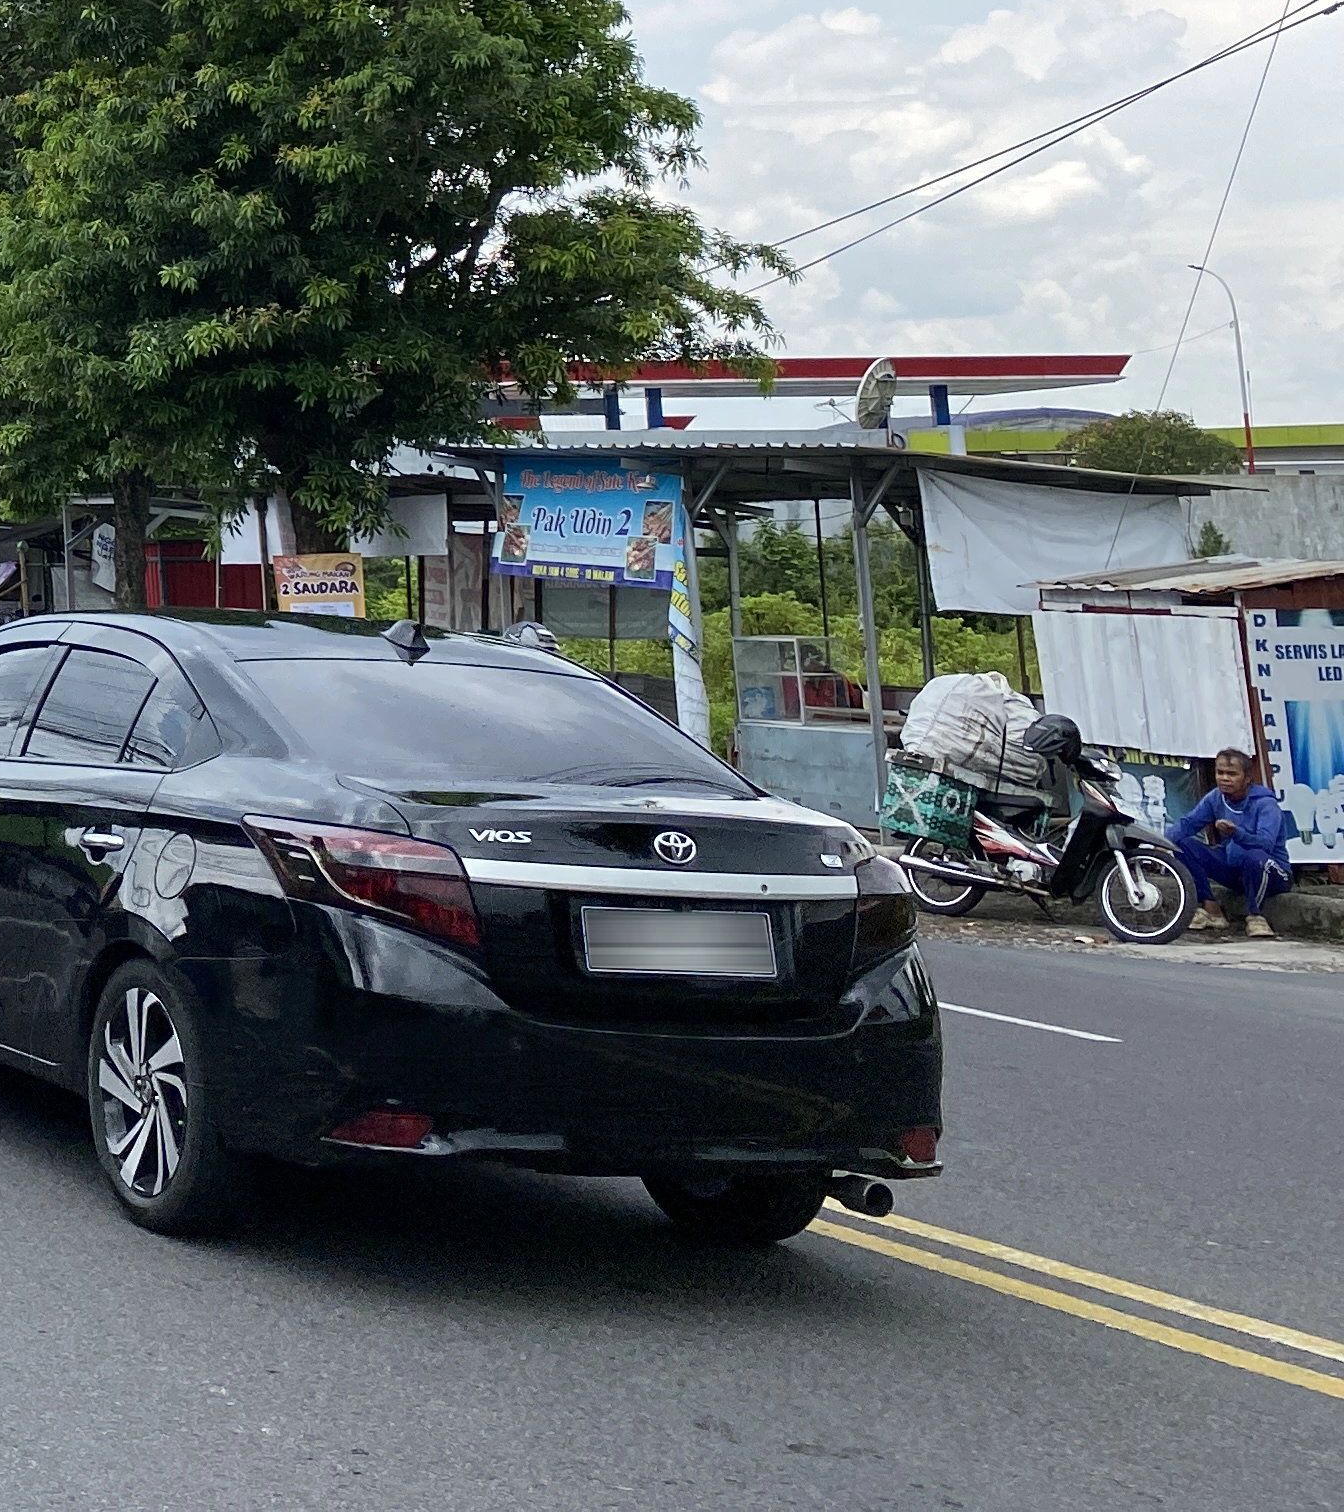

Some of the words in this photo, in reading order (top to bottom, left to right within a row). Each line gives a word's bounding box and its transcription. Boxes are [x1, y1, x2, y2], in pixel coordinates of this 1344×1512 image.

[521, 470, 540, 489] The
[543, 470, 583, 493] Legend
[585, 473, 597, 493] of
[532, 507, 566, 538] Pak
[570, 507, 612, 538] Udin
[615, 509, 632, 536] 2
[565, 567, 580, 578] SORE
[592, 569, 615, 581] MALAM
[282, 584, 289, 594] 2
[294, 580, 359, 595] SAUDARA
[1275, 644, 1327, 660] SERVIS
[1318, 666, 1342, 681] LED
[468, 828, 532, 844] VIOS
